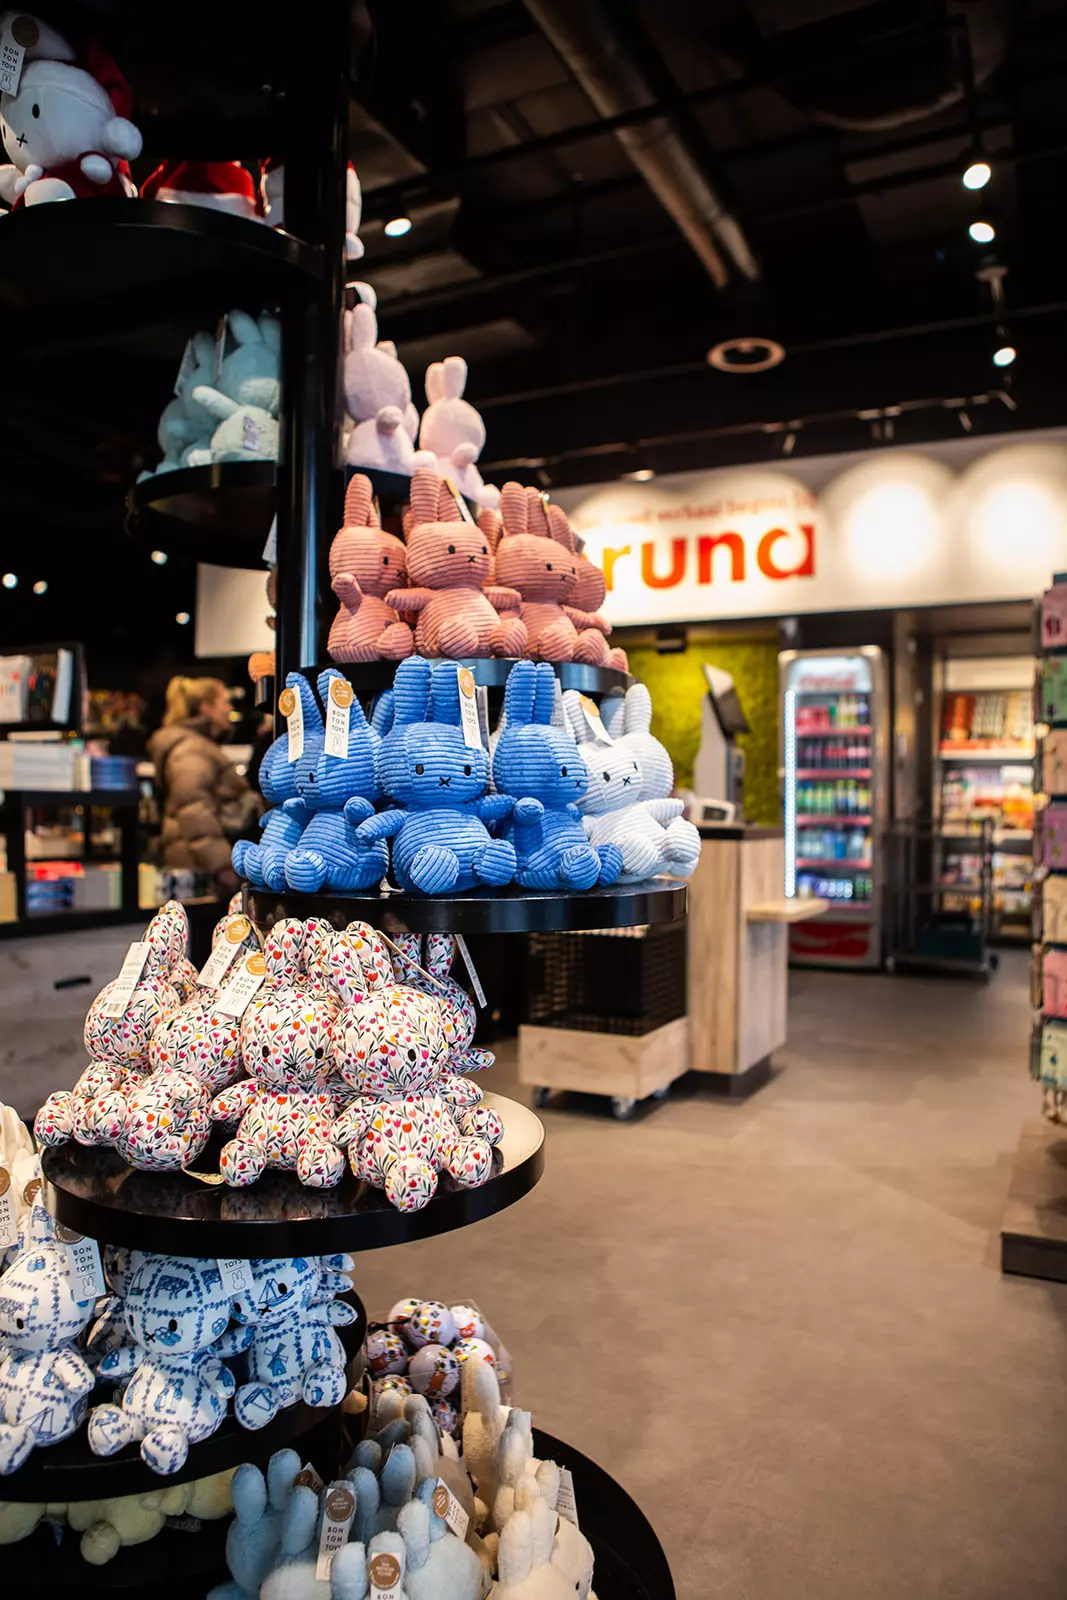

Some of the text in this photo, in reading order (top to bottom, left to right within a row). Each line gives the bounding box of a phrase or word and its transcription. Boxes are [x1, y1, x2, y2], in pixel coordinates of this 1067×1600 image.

[4, 45, 20, 57] BON
[2, 52, 18, 65] TON
[1, 60, 16, 72] TOYS
[582, 524, 815, 591] runa
[332, 709, 346, 718] BON
[332, 717, 345, 725] TON
[331, 724, 345, 734] TOYS
[238, 975, 256, 985] BON
[235, 981, 252, 990] TON
[231, 987, 248, 996] TOYS
[72, 1245, 93, 1257] BON
[74, 1254, 94, 1265] TON
[224, 1259, 243, 1269] TOYS
[75, 1263, 96, 1273] TOYS
[327, 1526, 344, 1534] BON
